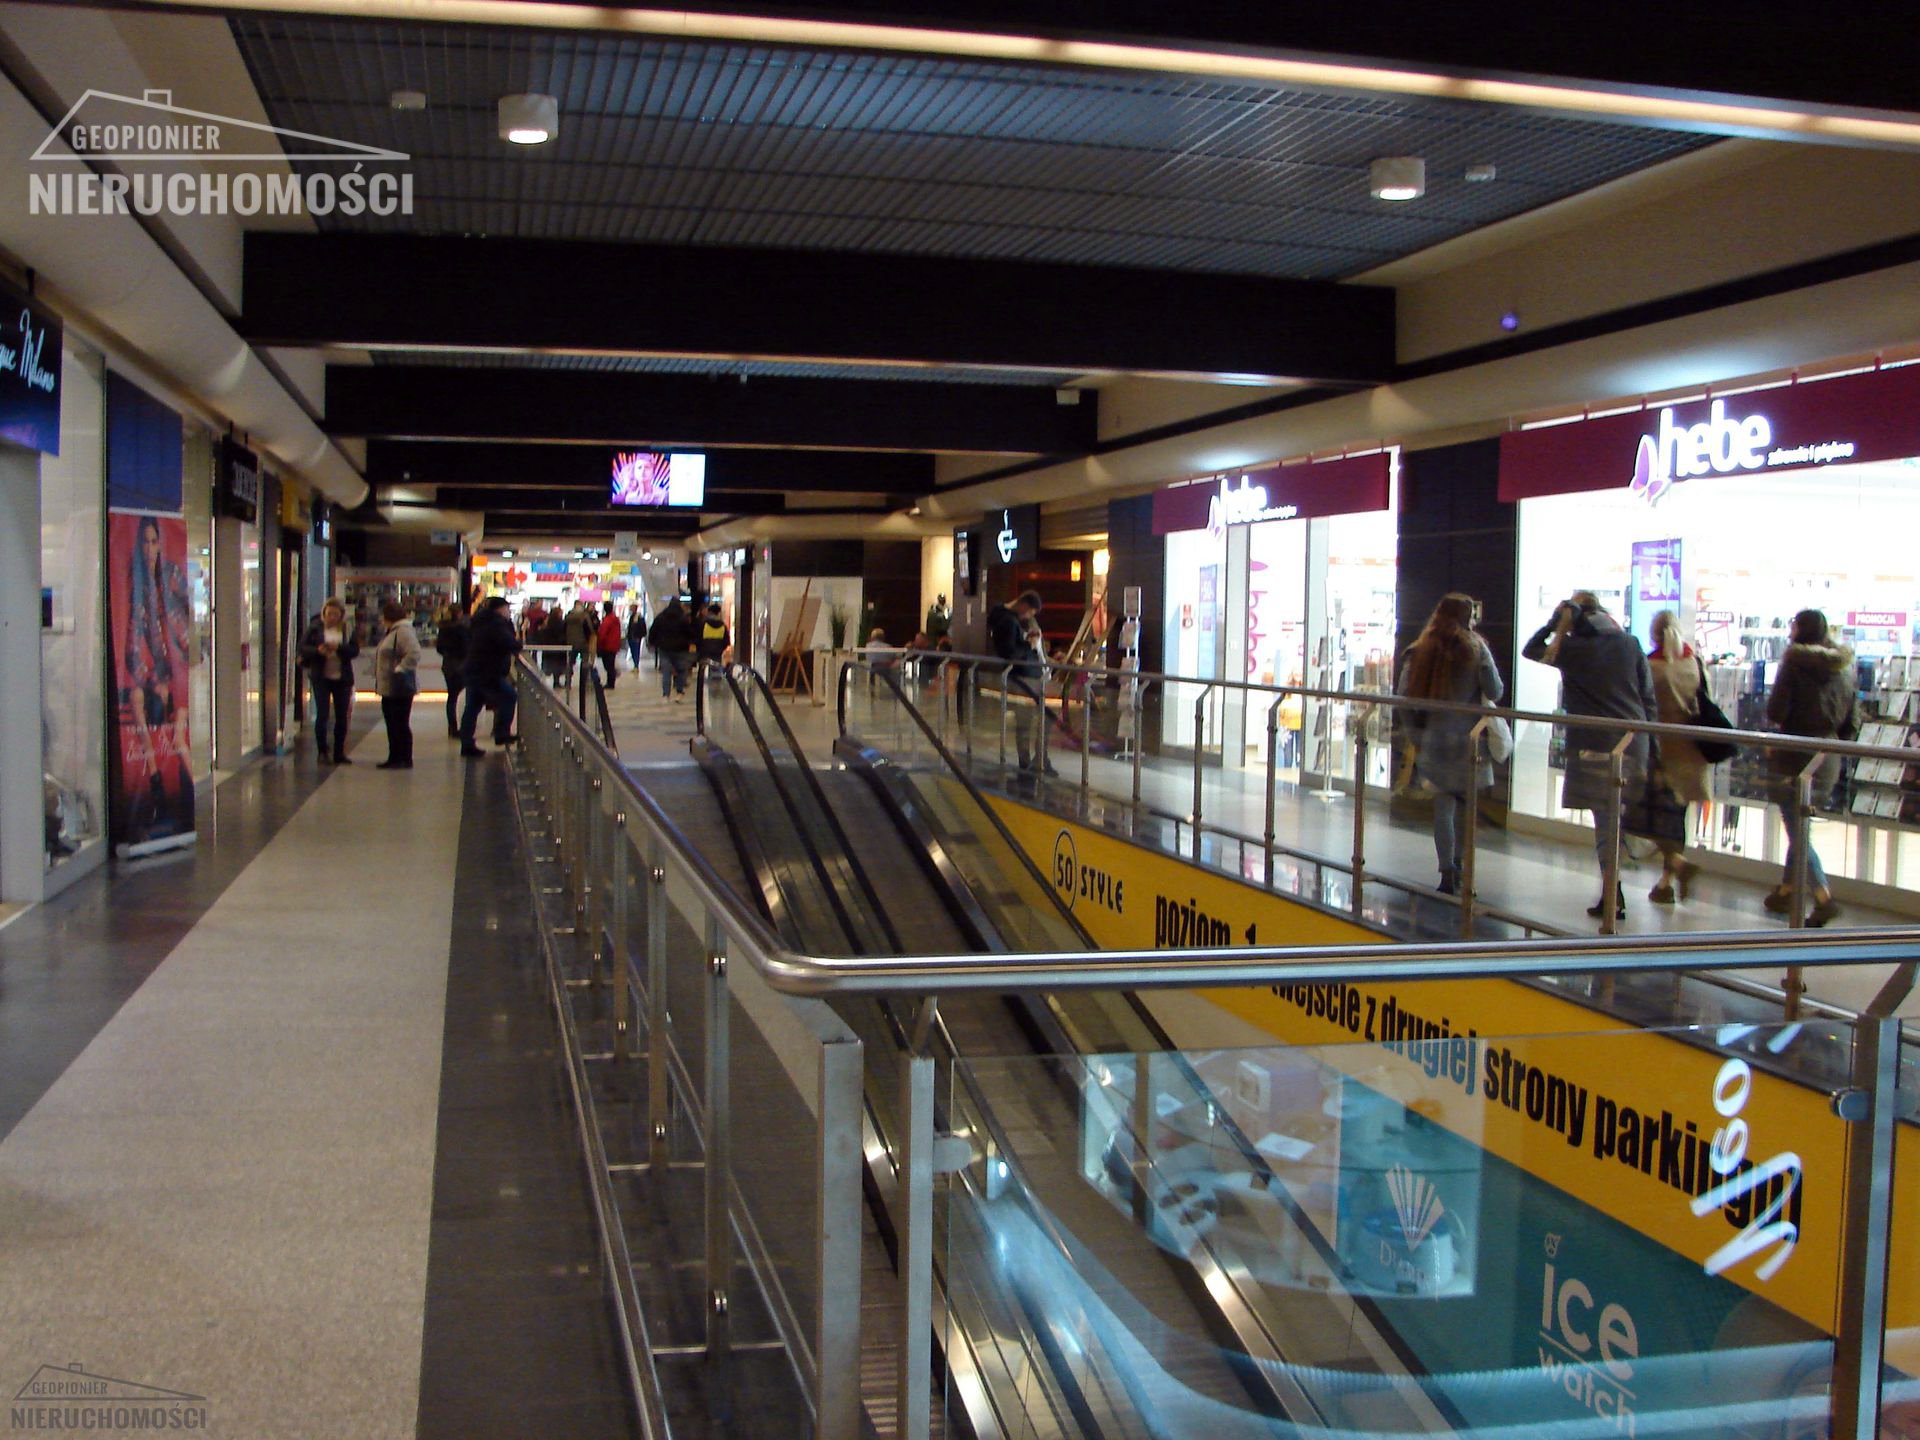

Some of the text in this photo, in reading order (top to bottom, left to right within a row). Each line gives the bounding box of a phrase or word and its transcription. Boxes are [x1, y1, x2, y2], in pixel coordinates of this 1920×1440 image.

[1658, 400, 1770, 477] hebe
[1081, 865, 1123, 914] STYLE
[1155, 894, 1231, 949] poziom
[1364, 996, 1376, 1043] z
[1381, 996, 1477, 1096] drugiej
[1483, 1046, 1588, 1148] strony
[1541, 1262, 1640, 1381] ice
[1539, 1346, 1636, 1440] watch
